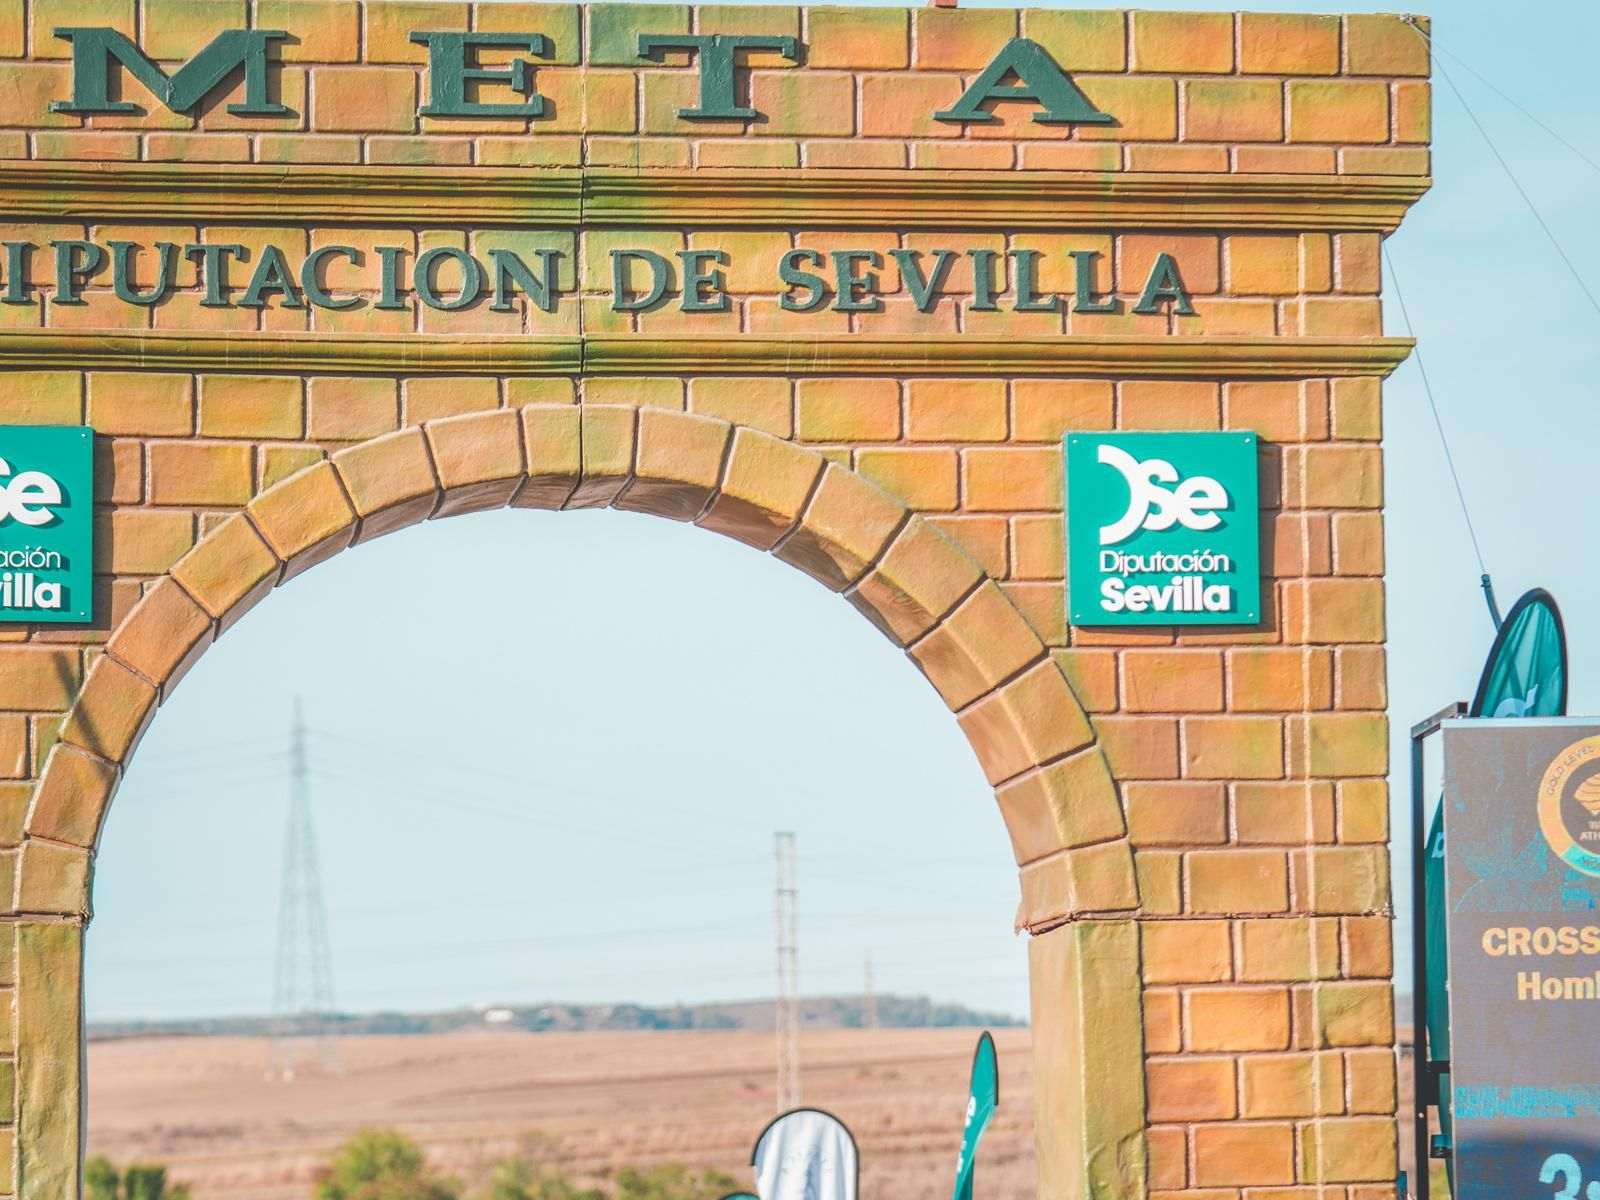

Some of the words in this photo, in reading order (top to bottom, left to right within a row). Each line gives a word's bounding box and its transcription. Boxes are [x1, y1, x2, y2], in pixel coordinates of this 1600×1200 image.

[48, 26, 1112, 123] META
[610, 248, 724, 313] DE
[777, 248, 1195, 315] SEVILLA
[1099, 549, 1230, 576] Diputación
[1100, 576, 1230, 612] Sevilla
[1482, 926, 1600, 956] CROSS
